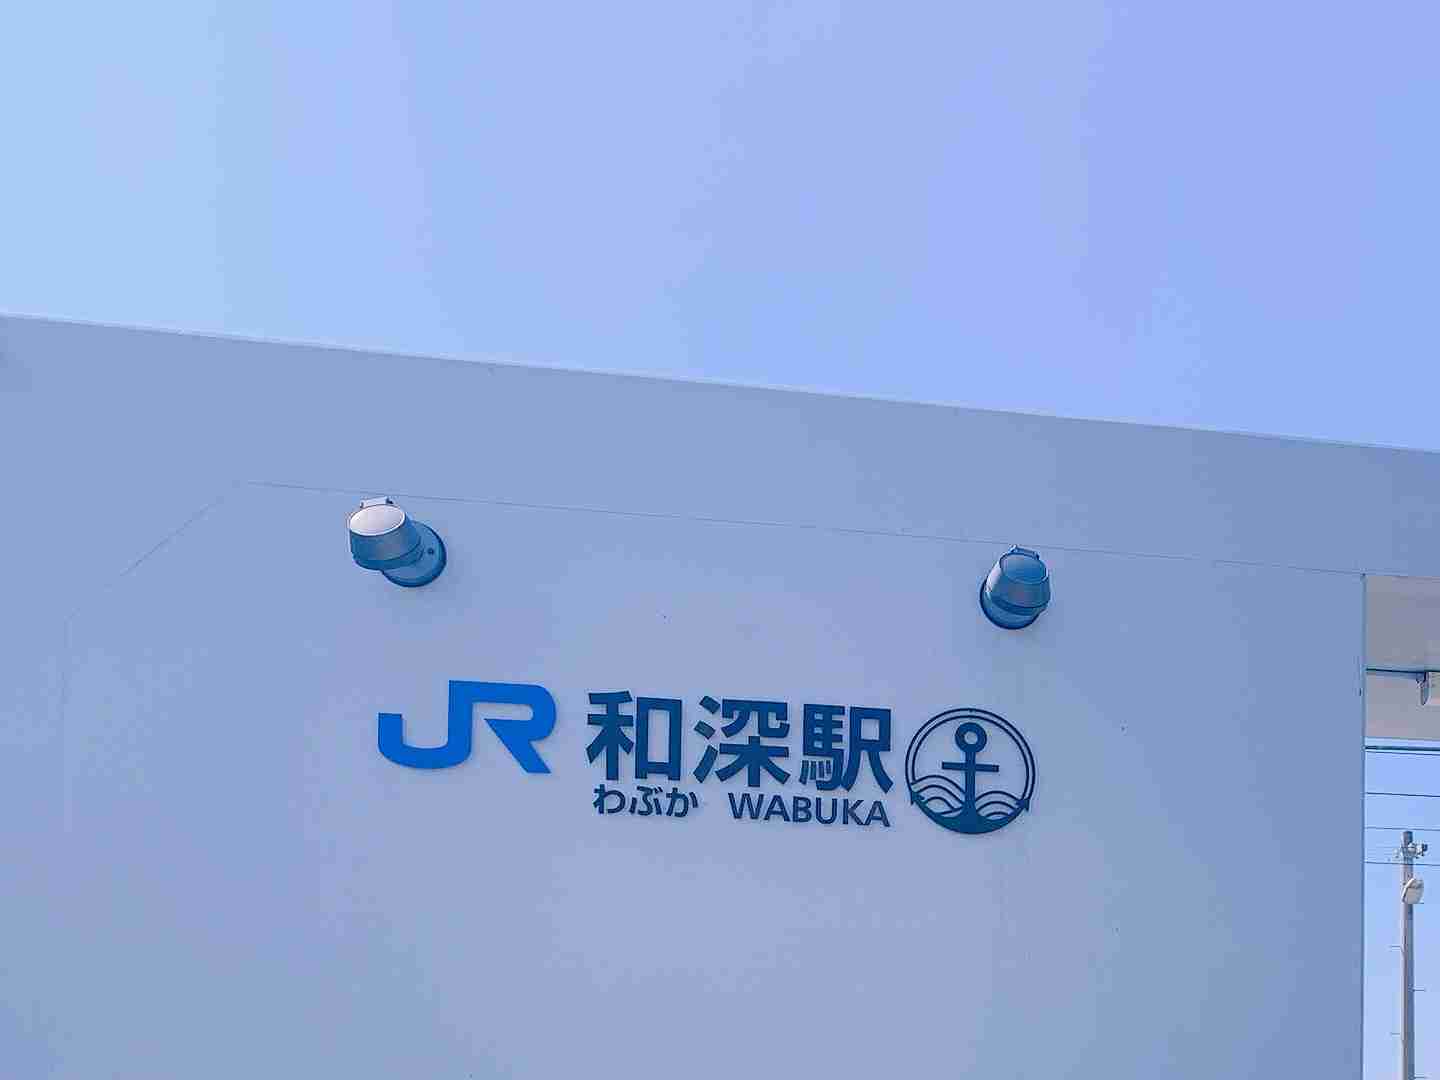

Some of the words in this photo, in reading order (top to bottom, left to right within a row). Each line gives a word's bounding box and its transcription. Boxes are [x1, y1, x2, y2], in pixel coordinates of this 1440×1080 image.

[378, 680, 557, 774] JR
[586, 689, 895, 793] 和深駅
[593, 784, 700, 819] わぶか
[728, 792, 891, 828] WABUKA
